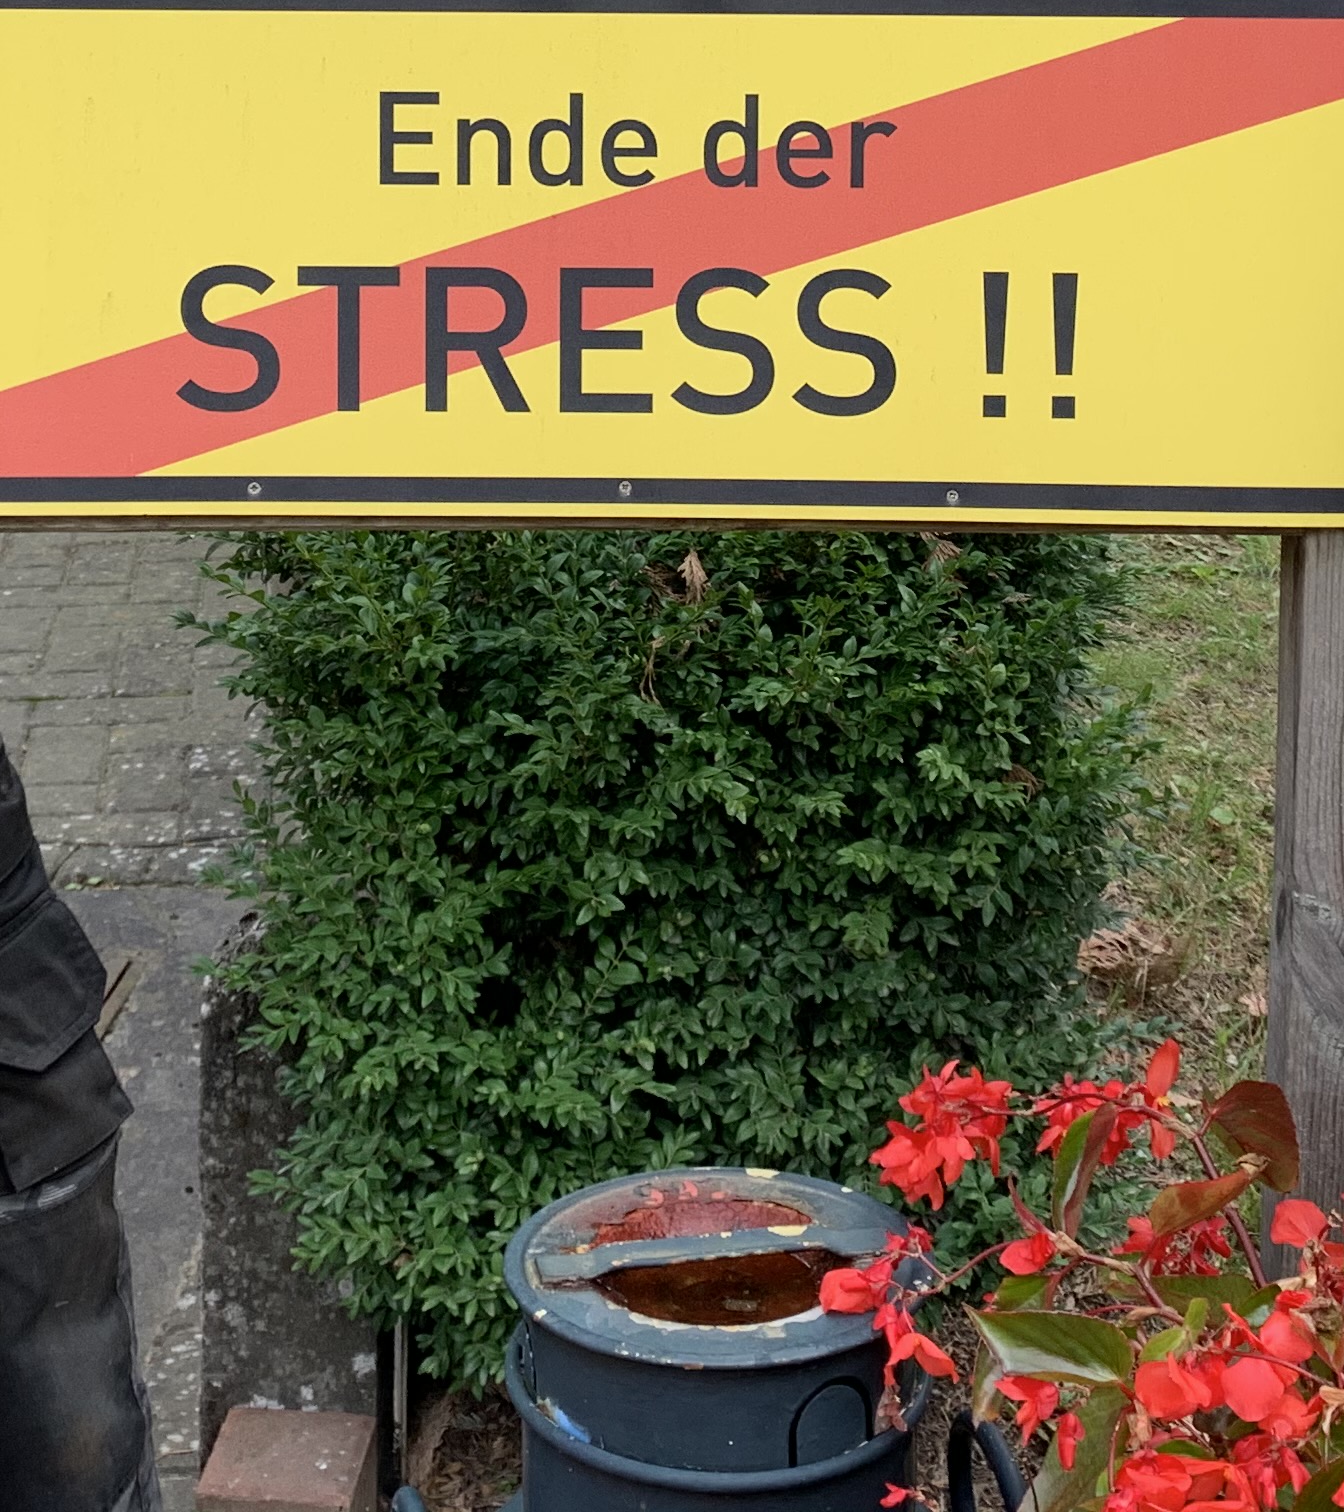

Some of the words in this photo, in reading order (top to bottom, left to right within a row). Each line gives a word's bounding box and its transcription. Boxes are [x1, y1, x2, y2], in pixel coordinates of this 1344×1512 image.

[379, 91, 658, 187] Ende
[703, 94, 897, 188] der
[176, 264, 897, 417] STRESS
[982, 271, 1078, 419] !!
